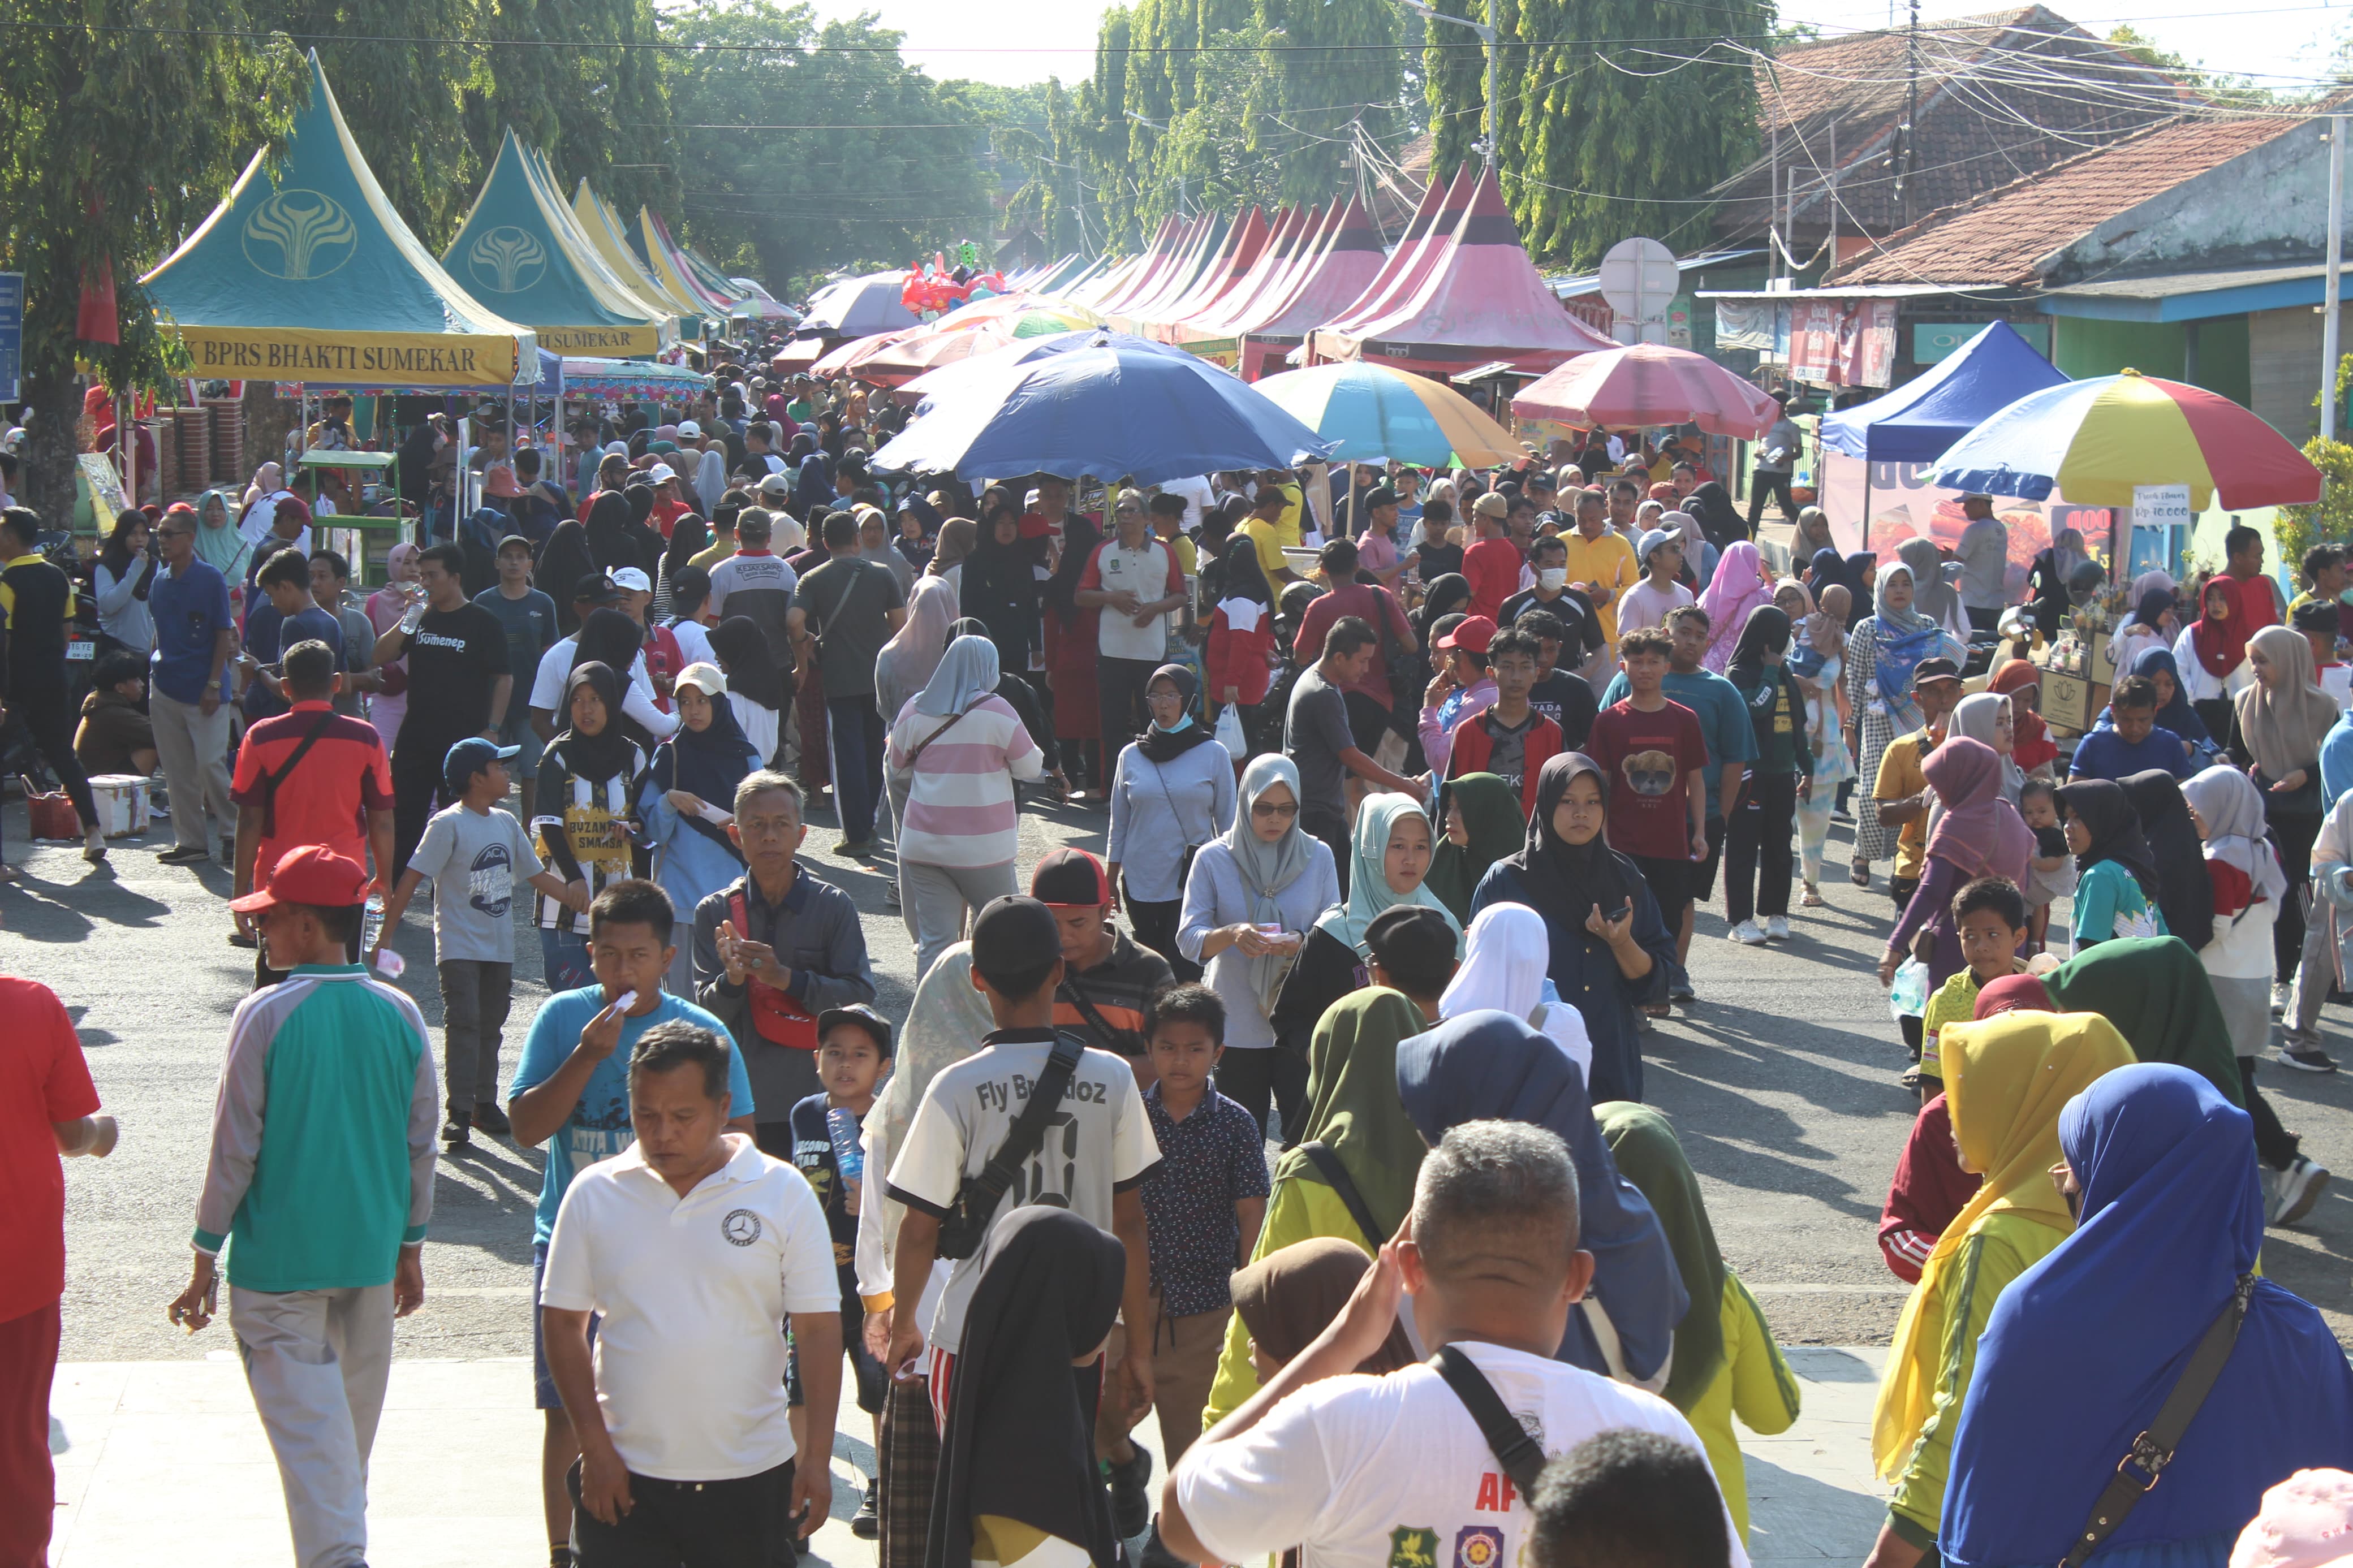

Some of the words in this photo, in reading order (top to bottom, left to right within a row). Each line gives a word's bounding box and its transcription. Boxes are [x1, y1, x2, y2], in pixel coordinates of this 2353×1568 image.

[554, 331, 631, 348] SUMEKAR
[1208, 340, 1236, 351] PERAS
[204, 340, 261, 367] BPRS
[267, 343, 356, 370] BHAKTI
[363, 346, 476, 372] SUMEKAR
[975, 1080, 1007, 1113] Fly
